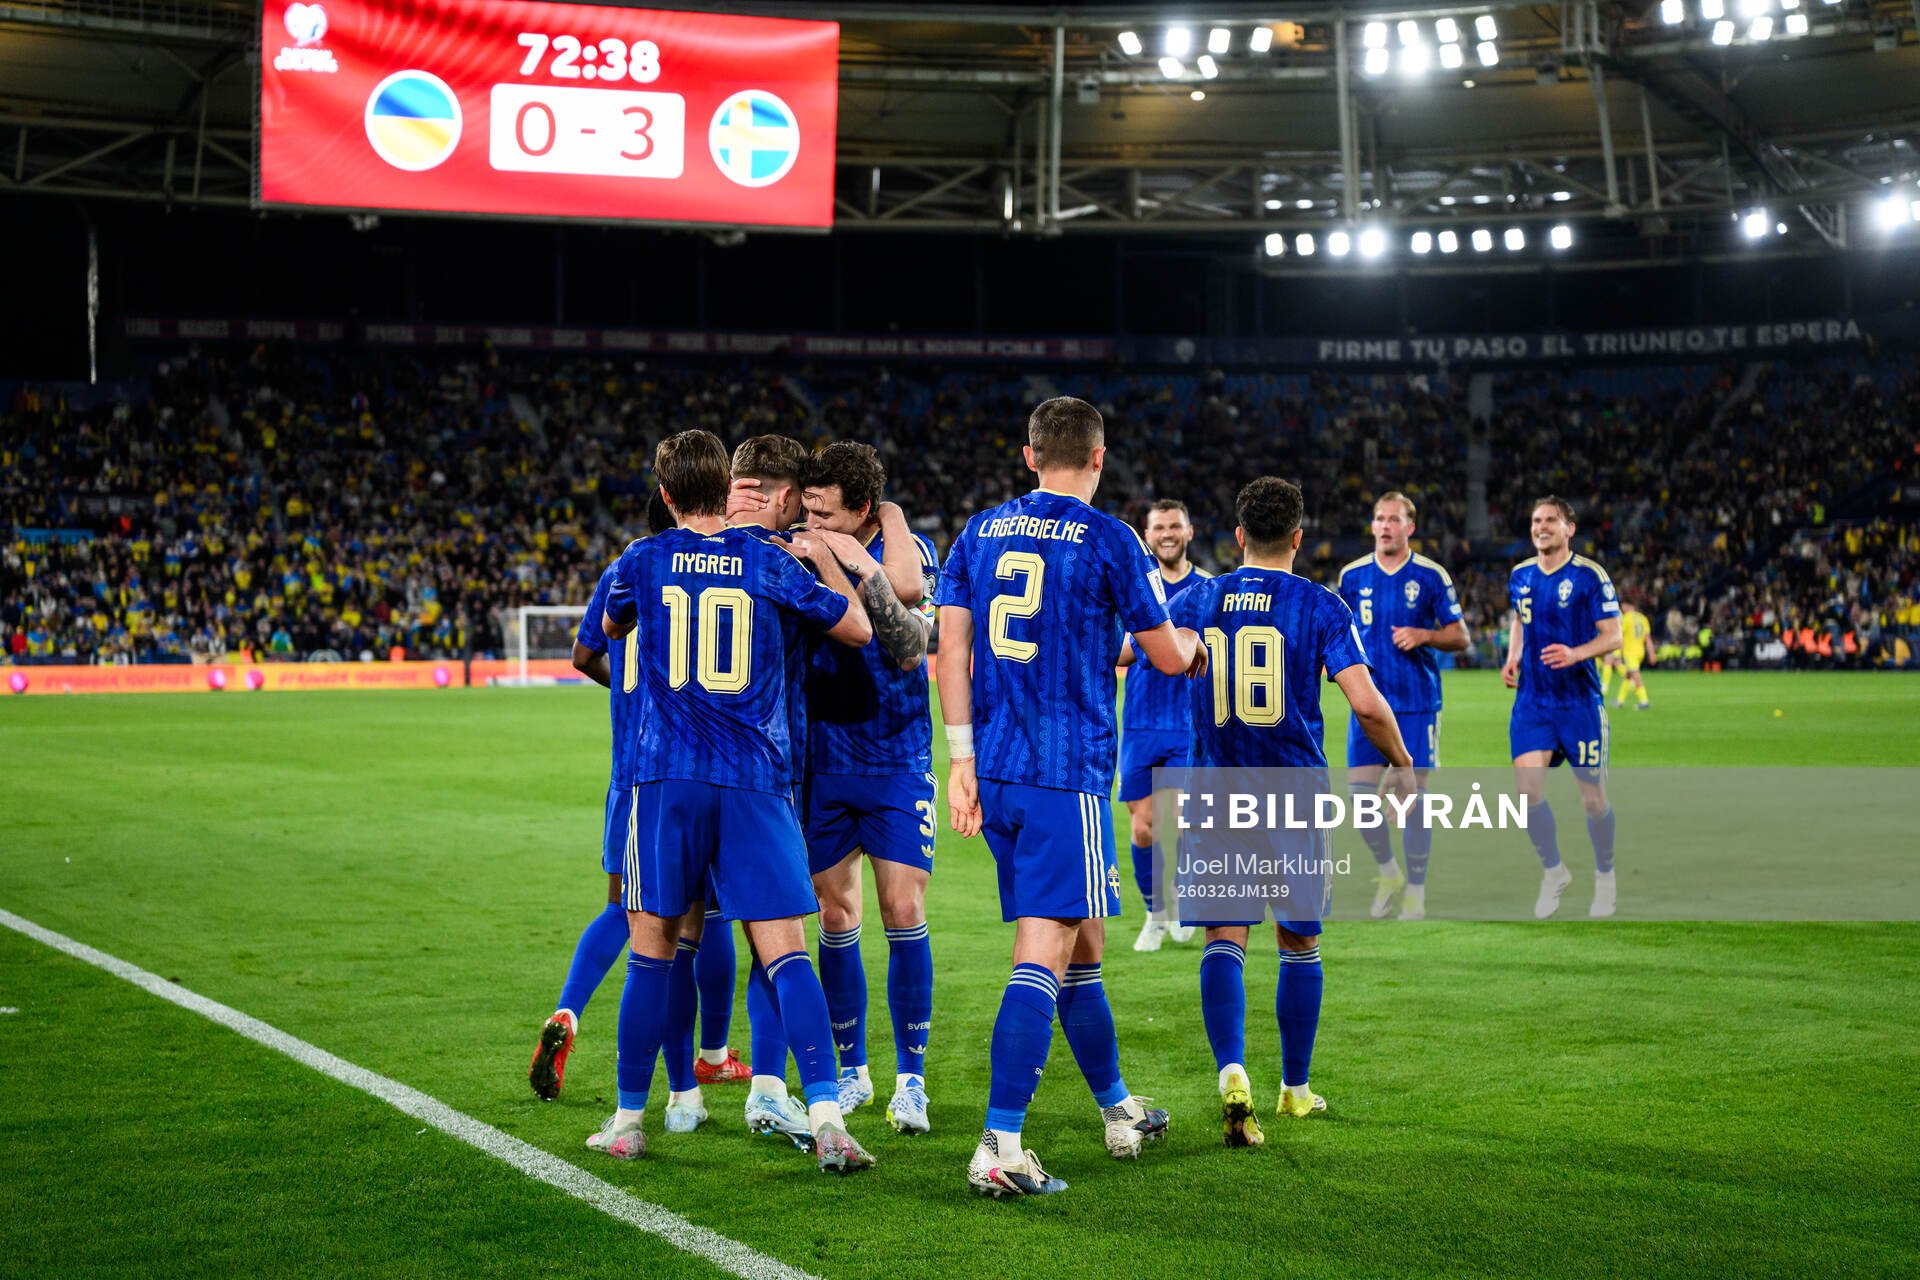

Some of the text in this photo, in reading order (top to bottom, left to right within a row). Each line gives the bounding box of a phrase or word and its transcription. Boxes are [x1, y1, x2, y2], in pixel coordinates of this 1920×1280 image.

[517, 33, 661, 83] 72:38
[514, 100, 557, 157] 0
[618, 106, 656, 161] 3
[1319, 340, 1400, 361] FIRME
[1410, 338, 1446, 360] TU
[1453, 336, 1529, 359] PASO
[1541, 335, 1576, 356] EL
[1713, 326, 1748, 348] TE
[1756, 319, 1861, 347] ESPERA
[978, 515, 1089, 544] LAGERBIELKE
[672, 552, 743, 577] NYGREN
[989, 551, 1046, 663] 2
[1223, 592, 1273, 612] AYARI
[1359, 599, 1373, 626] 6
[662, 585, 753, 694] 10
[1204, 625, 1285, 727] 18
[1578, 740, 1600, 766] 15
[915, 800, 937, 838] 3
[832, 1017, 858, 1030] VERIGE
